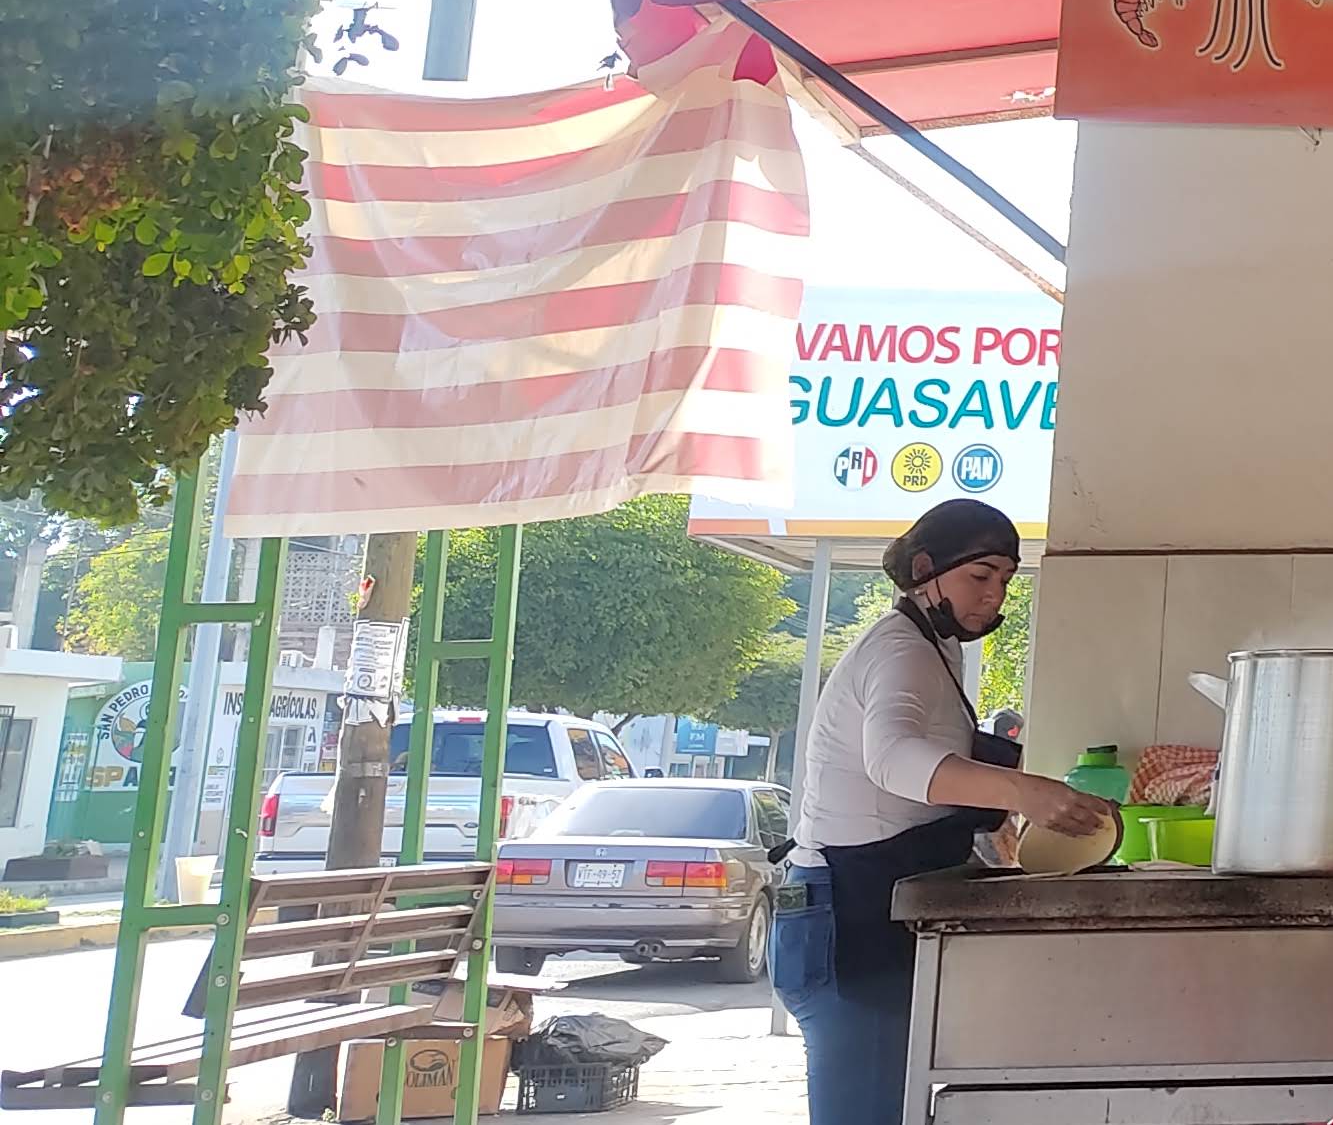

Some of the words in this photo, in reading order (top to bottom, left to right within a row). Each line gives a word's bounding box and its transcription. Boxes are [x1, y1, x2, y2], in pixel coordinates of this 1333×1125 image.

[796, 323, 961, 364] VAMOS
[973, 326, 1061, 366] POR
[835, 451, 874, 478] PRI
[961, 456, 994, 481] PAN
[903, 475, 928, 486] PRD
[100, 713, 115, 741] SAN
[108, 684, 150, 713] PEDRO
[403, 1058, 459, 1089] OLIMAN
